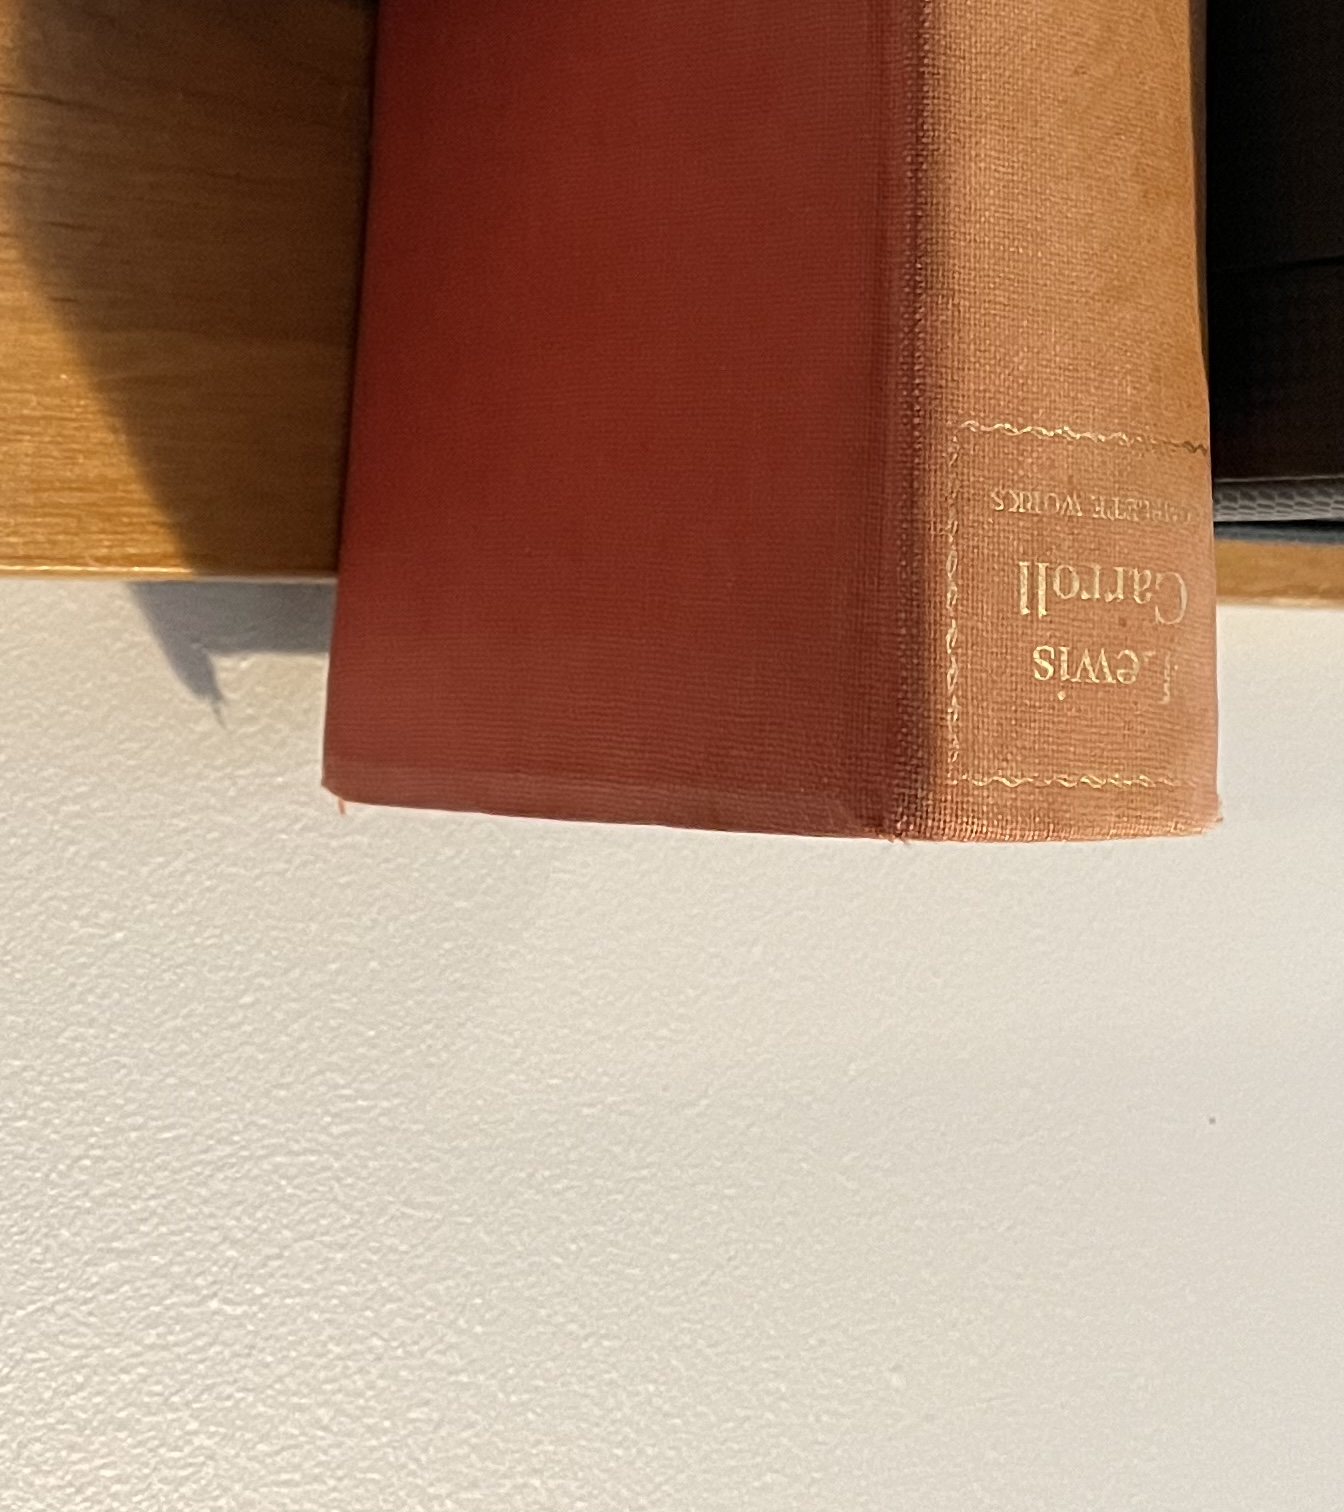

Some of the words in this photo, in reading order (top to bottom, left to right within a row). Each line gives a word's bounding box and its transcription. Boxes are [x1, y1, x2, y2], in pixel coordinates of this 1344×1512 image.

[990, 487, 1084, 518] WORKS
[1090, 494, 1202, 523] MPLETE
[1017, 560, 1188, 625] Carroll
[1032, 645, 1178, 706] Lewis
